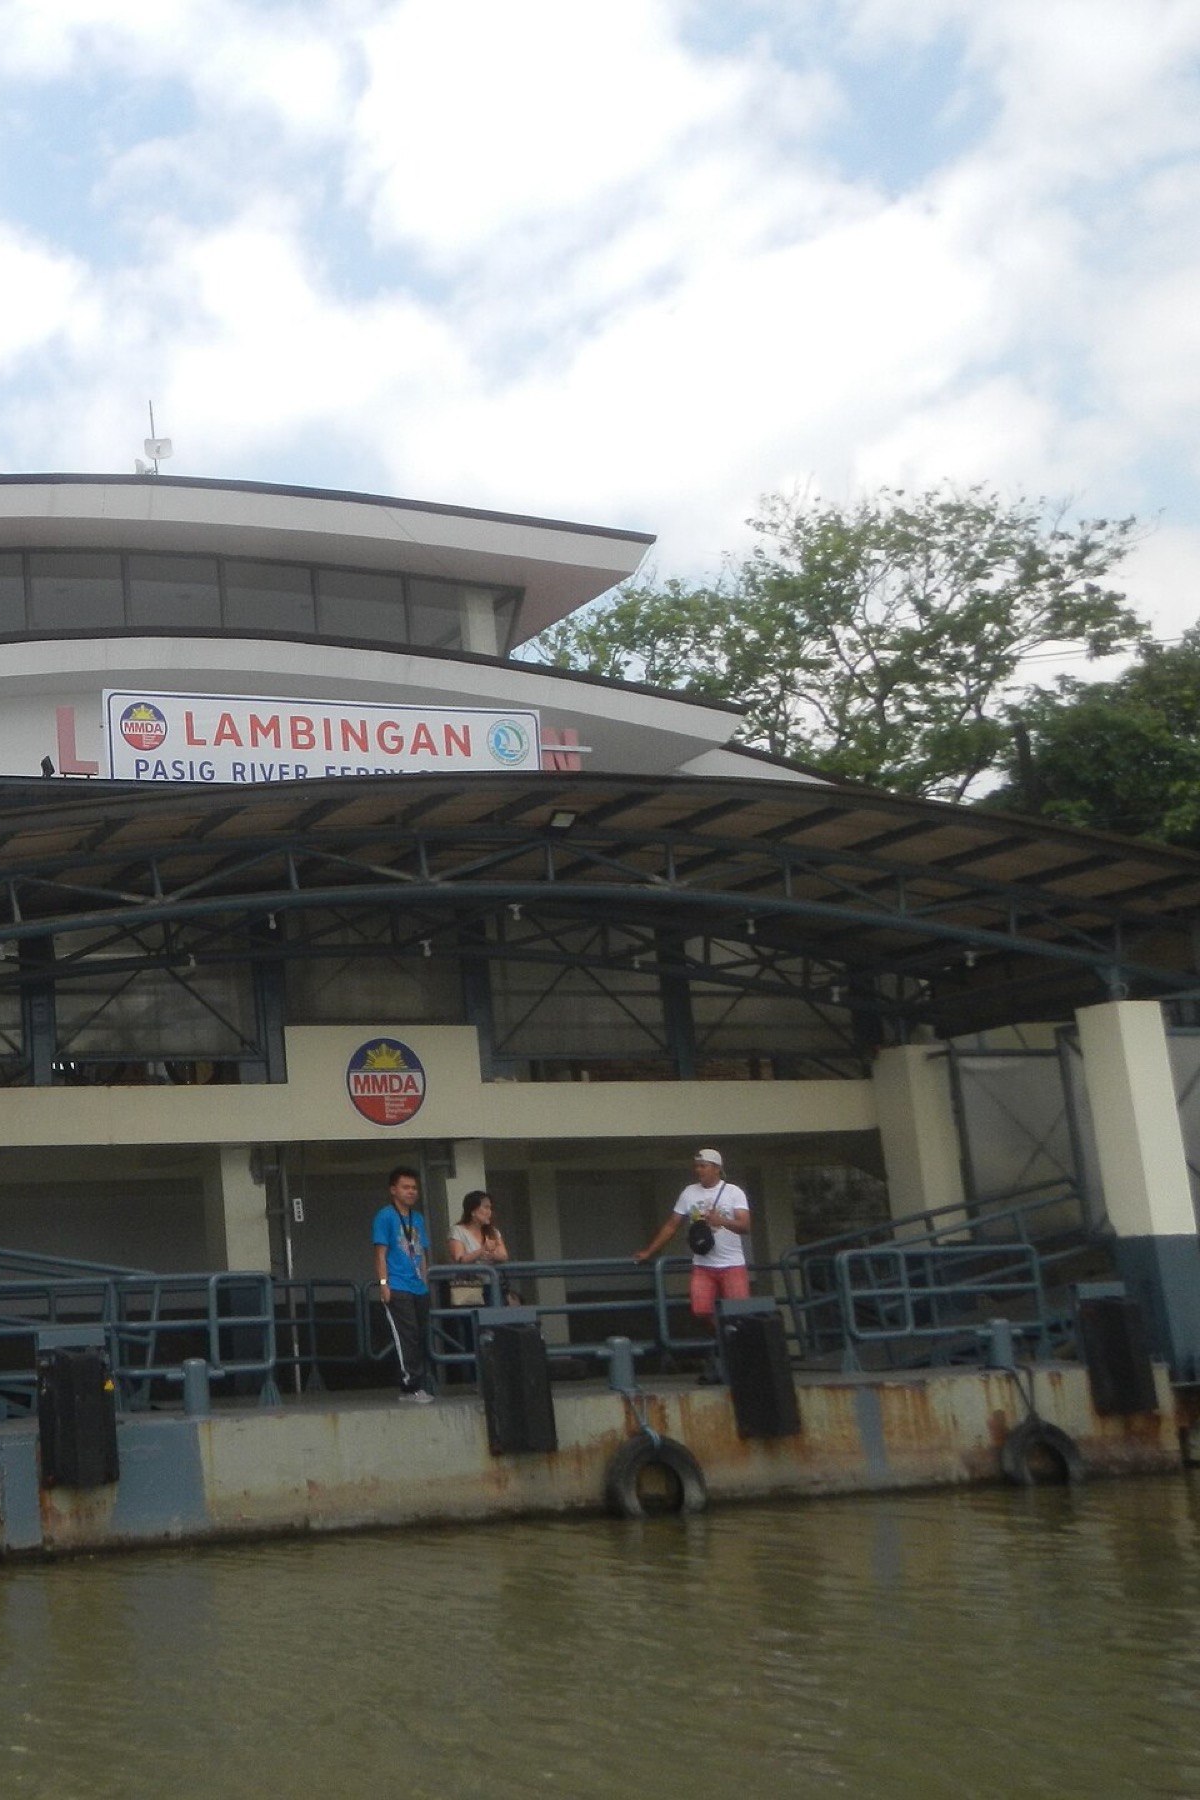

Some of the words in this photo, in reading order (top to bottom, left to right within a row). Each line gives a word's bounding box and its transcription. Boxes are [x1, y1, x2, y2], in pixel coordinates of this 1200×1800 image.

[124, 722, 163, 733] MMDA
[185, 711, 471, 757] LAMBINGAN
[135, 758, 215, 781] PASIG
[232, 762, 308, 782] RIVER
[354, 1074, 419, 1094] MMDA
